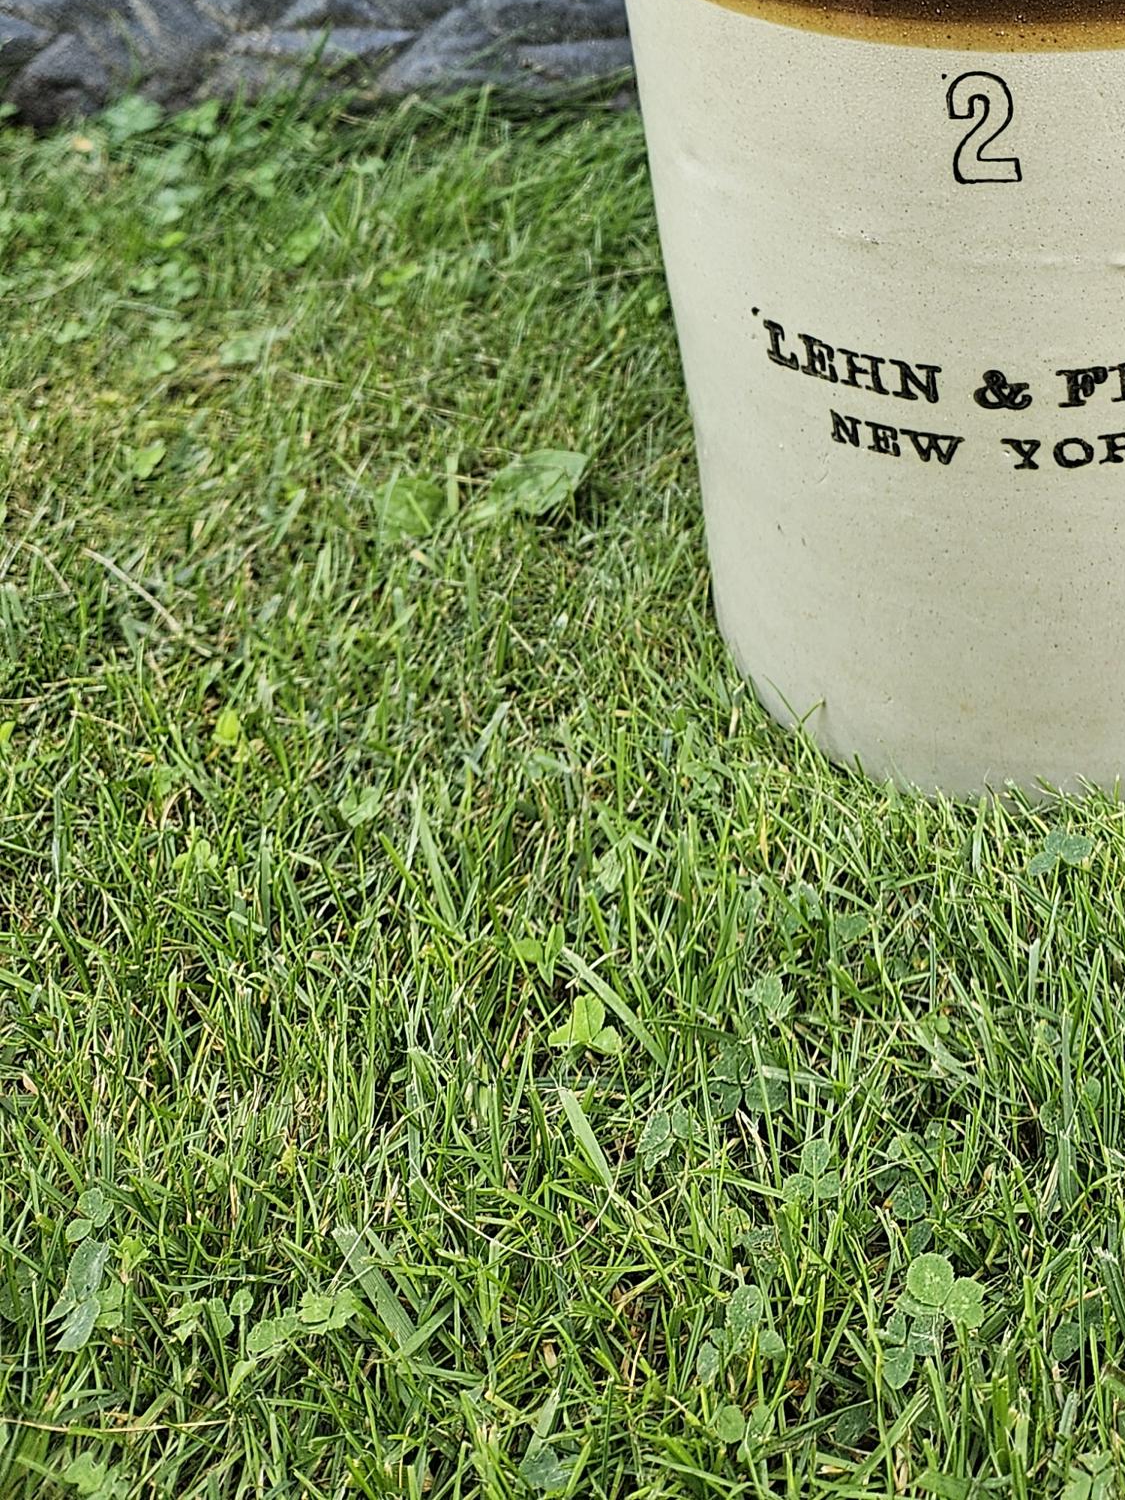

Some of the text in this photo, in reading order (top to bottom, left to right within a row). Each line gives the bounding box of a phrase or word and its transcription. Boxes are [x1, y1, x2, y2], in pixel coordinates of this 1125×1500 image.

[946, 71, 1022, 184] 2
[762, 319, 941, 403] LEHN
[973, 369, 1033, 410] &
[829, 409, 965, 466] NEW
